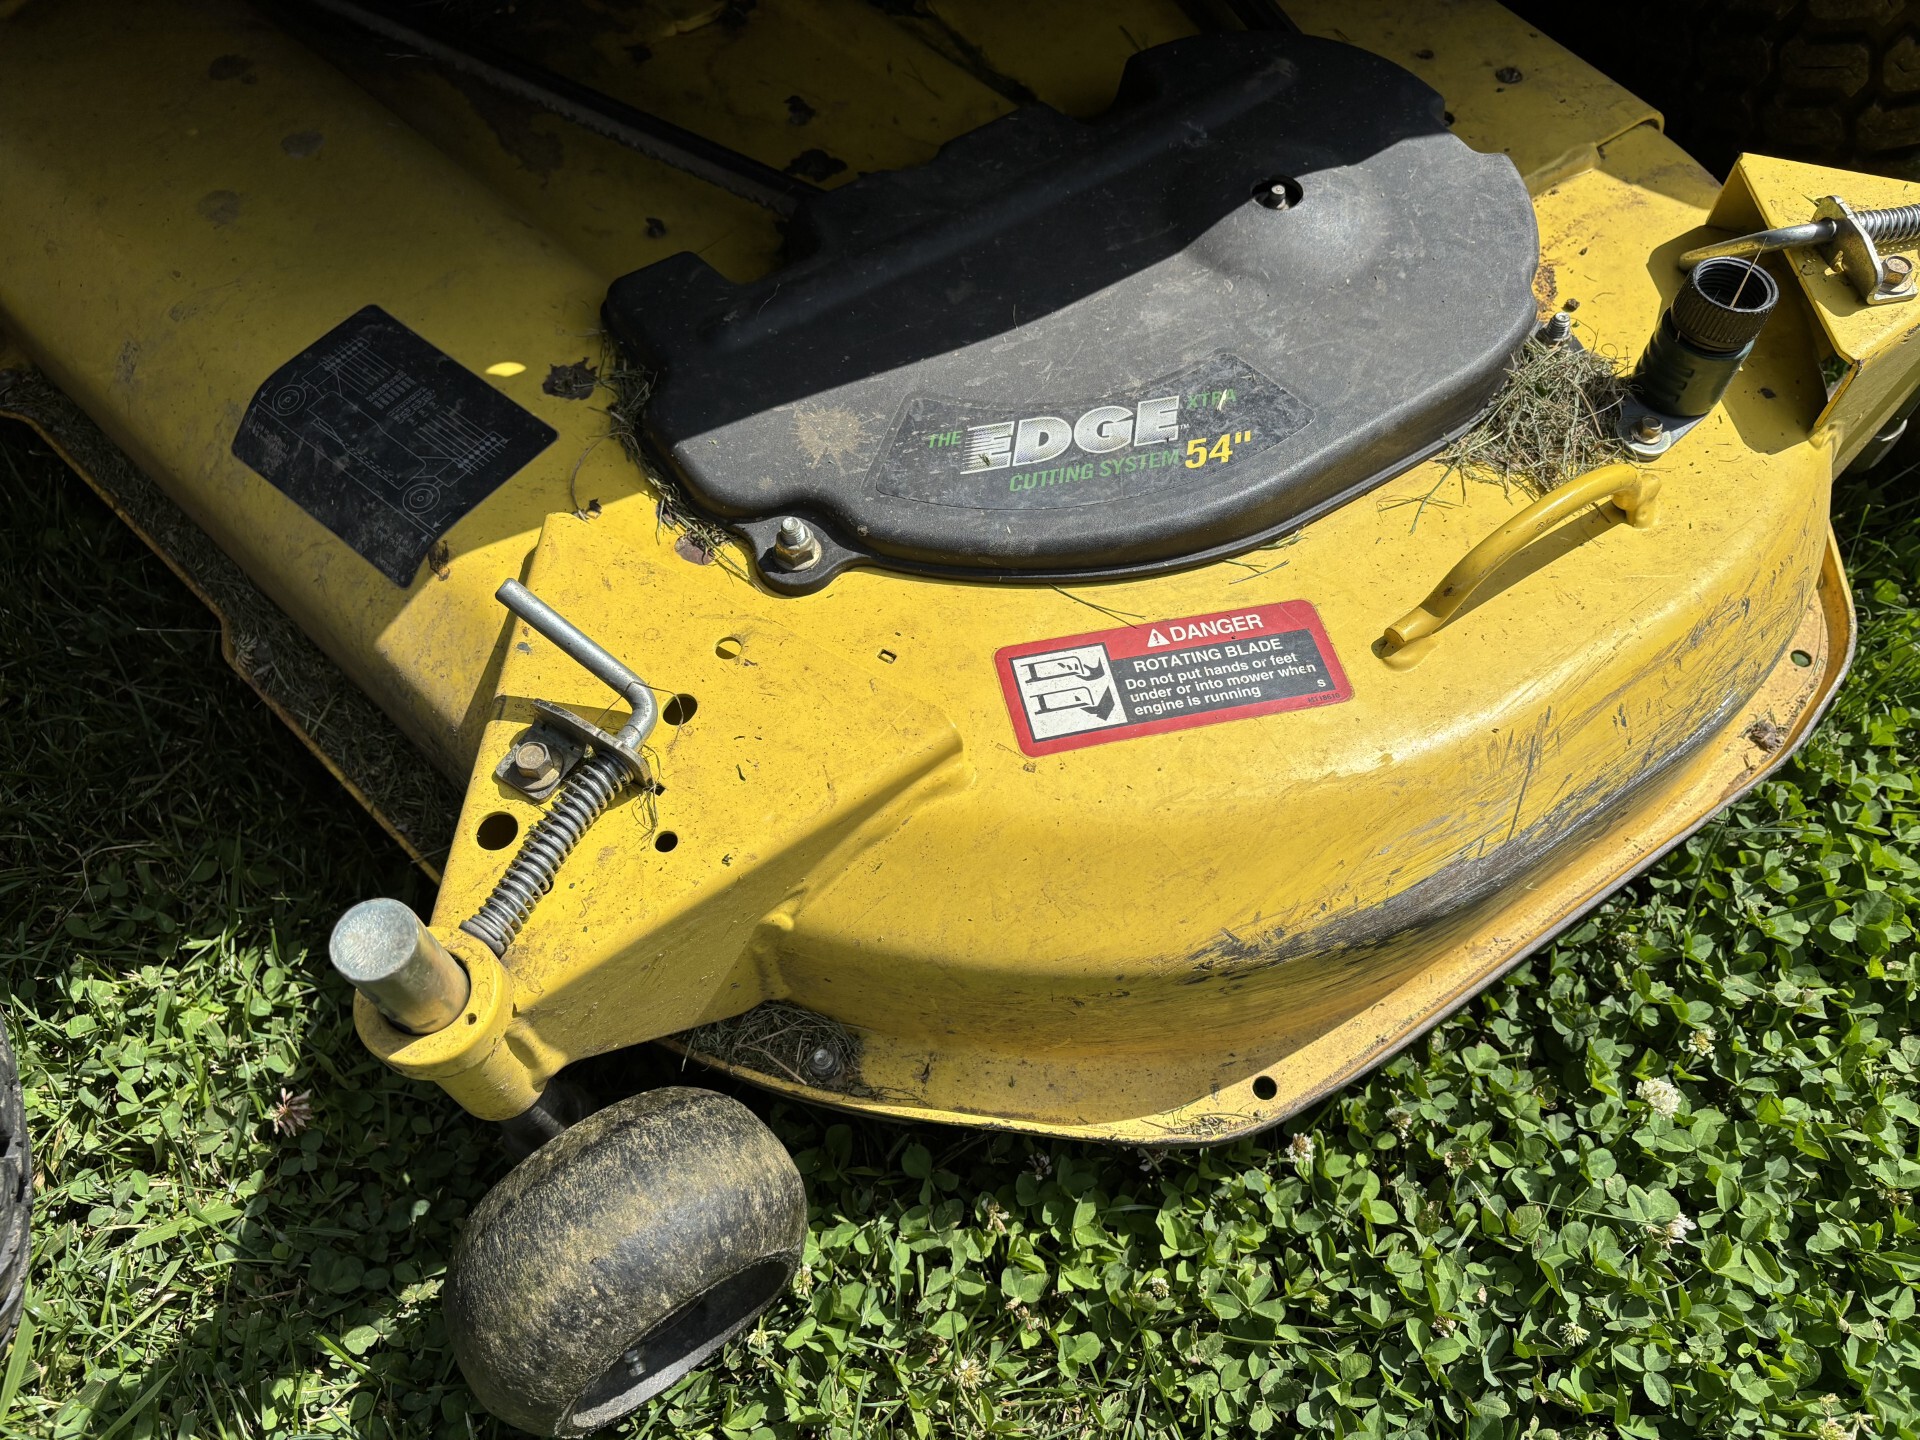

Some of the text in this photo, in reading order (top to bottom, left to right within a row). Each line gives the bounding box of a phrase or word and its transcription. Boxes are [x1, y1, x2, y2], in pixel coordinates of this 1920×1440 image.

[928, 431, 962, 449] THE
[960, 395, 1180, 475] EDGE
[1188, 388, 1237, 409] XTRA
[1009, 430, 1252, 492] CUTTING SYSTEM 54"
[1169, 614, 1264, 642] DANGER
[1125, 652, 1298, 690] Do not put hands or feet
[1133, 638, 1283, 673] ROTATING BLADE
[1129, 663, 1317, 703] under or into mower when
[1134, 685, 1261, 716] engine is running
